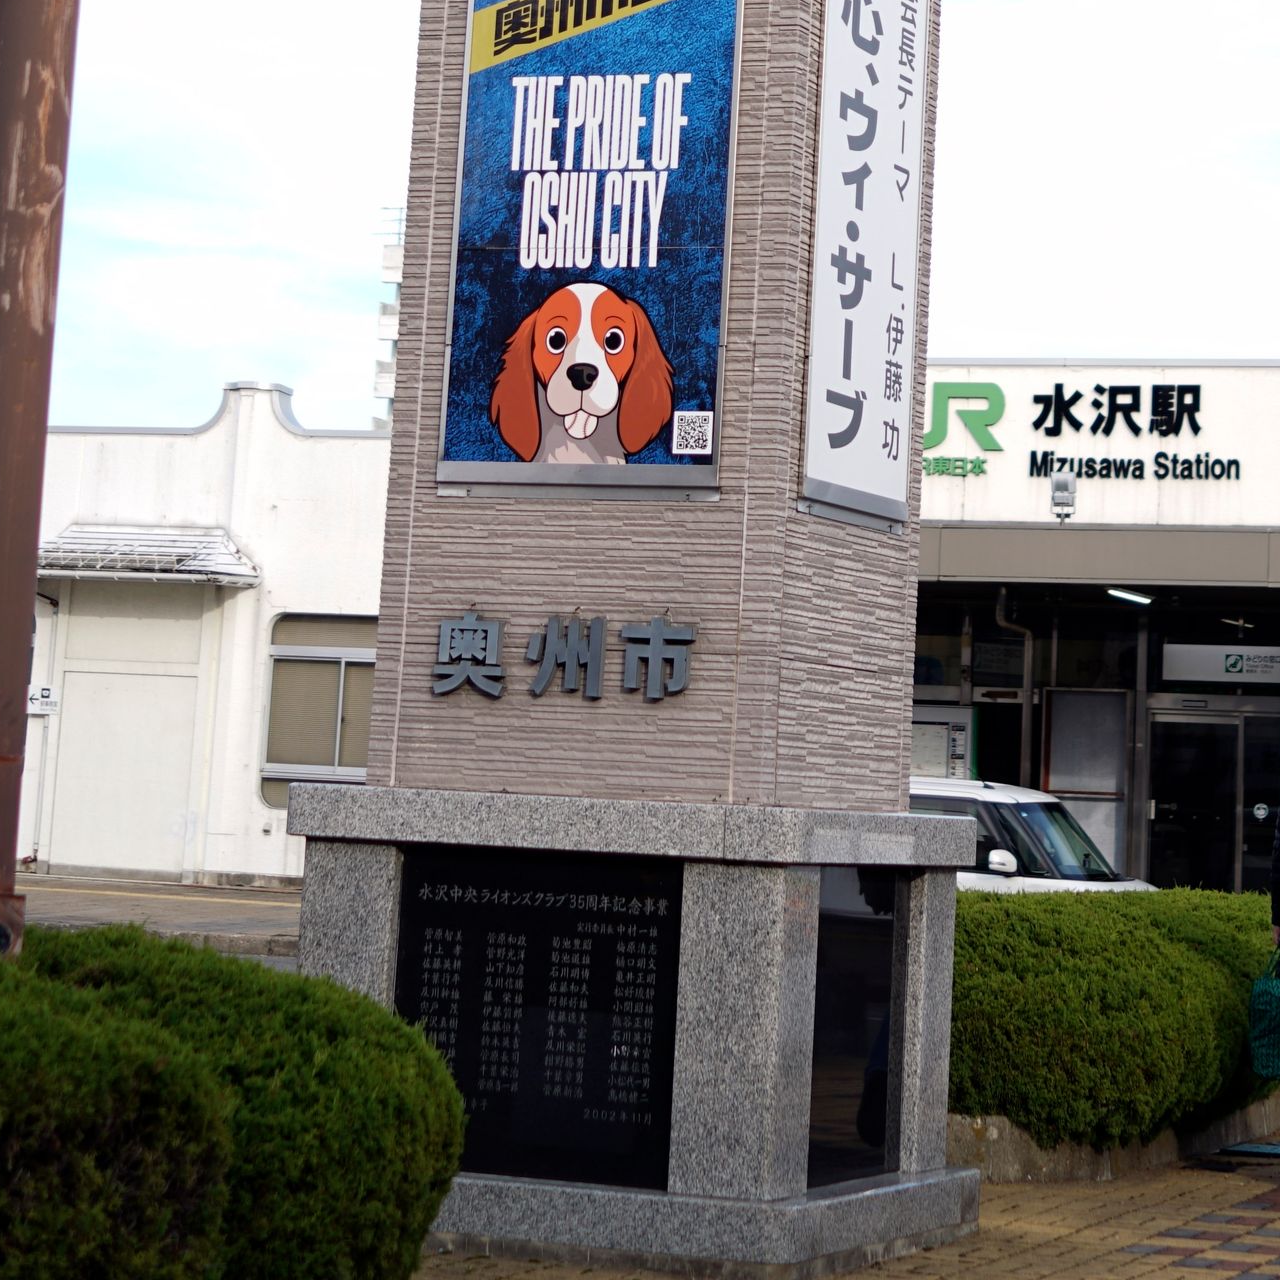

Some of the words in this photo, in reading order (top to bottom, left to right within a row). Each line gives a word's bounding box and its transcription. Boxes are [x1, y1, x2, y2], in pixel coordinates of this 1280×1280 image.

[511, 74, 563, 171] THE
[564, 74, 650, 170] PRIDE
[652, 73, 691, 170] OF
[519, 171, 598, 269] OSHU
[601, 171, 668, 268] CITY
[923, 382, 1006, 451] JR
[1032, 383, 1201, 437] 水沢駅
[1029, 450, 1145, 480] Mizusawa
[1154, 451, 1241, 480] Station
[432, 612, 697, 699] 奥州市
